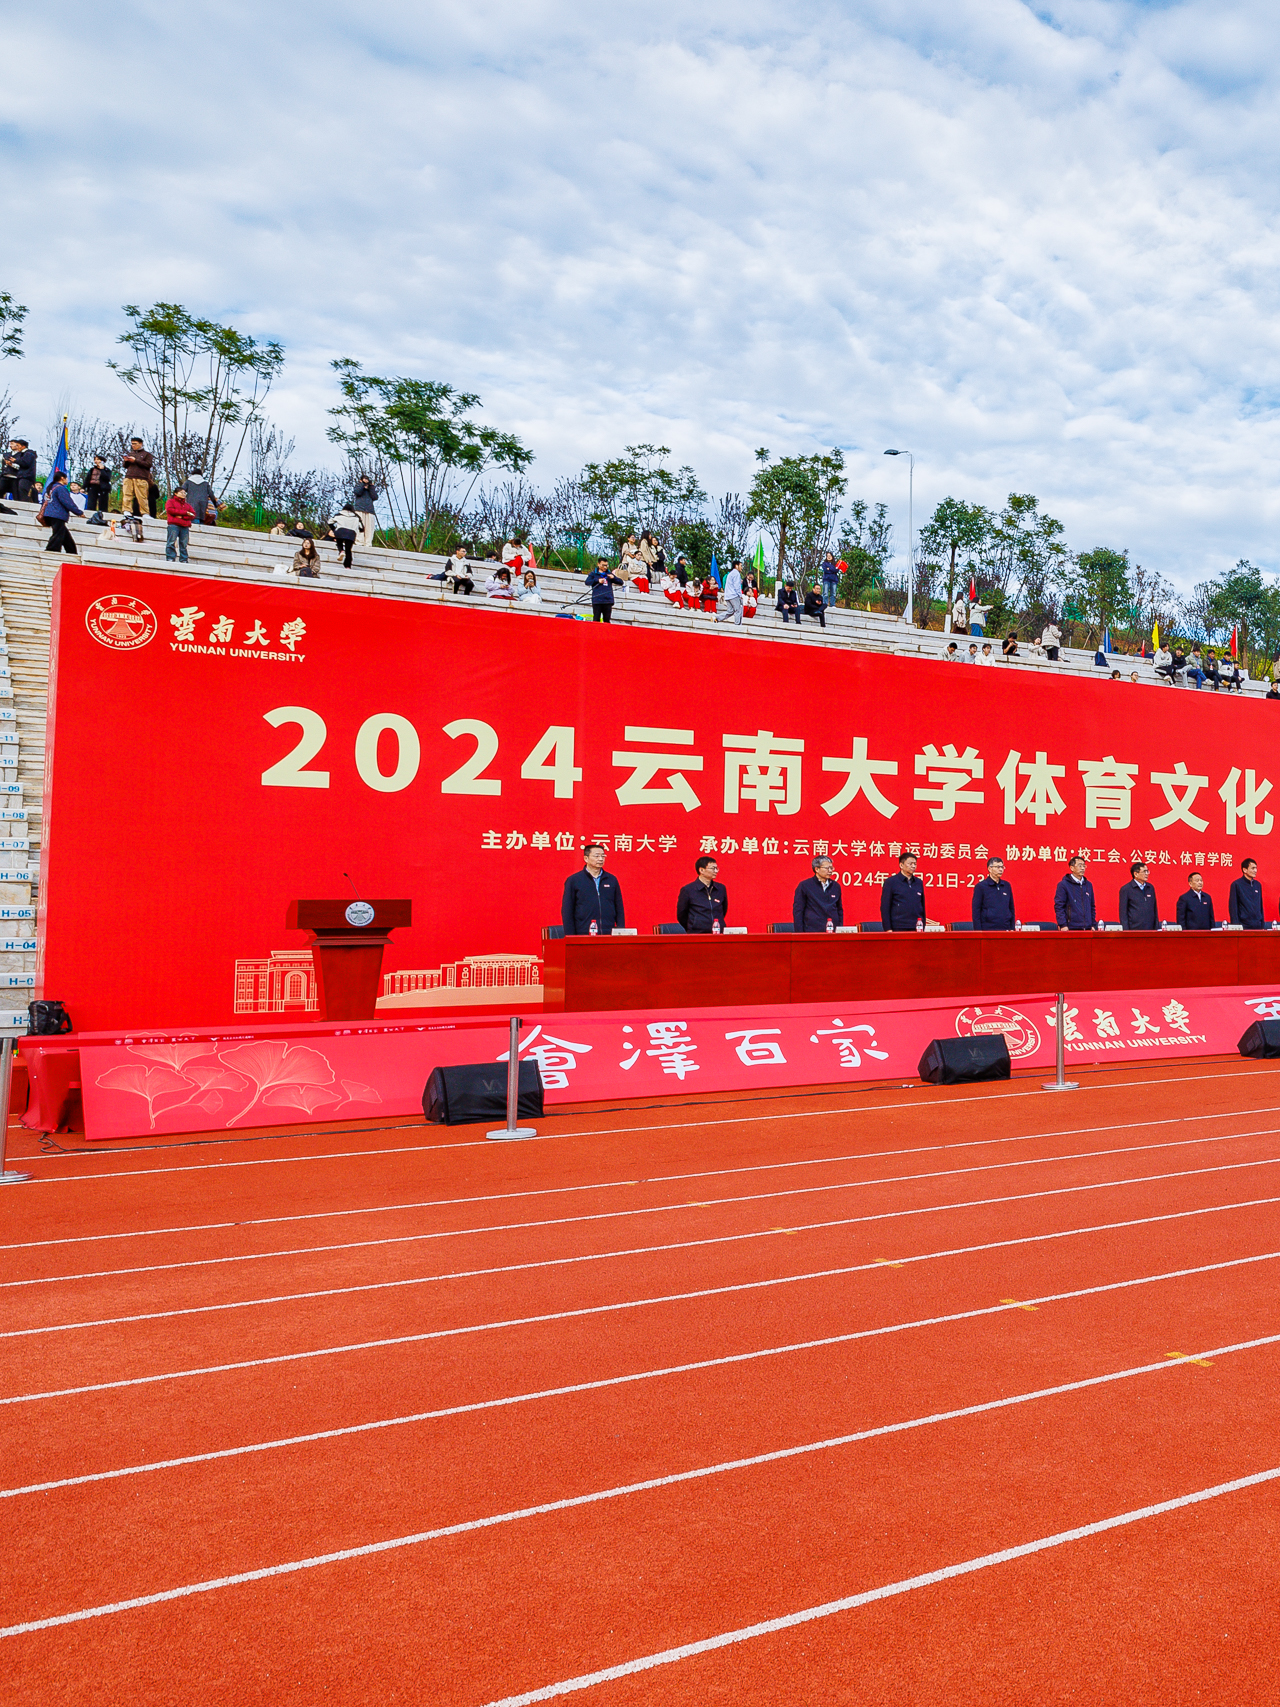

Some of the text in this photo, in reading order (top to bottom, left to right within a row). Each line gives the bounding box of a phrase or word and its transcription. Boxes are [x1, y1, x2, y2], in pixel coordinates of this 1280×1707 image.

[114, 624, 153, 647] UNIVERSITY
[170, 642, 306, 663] YUNNAN UNIVERSITY
[0, 785, 20, 793] -09
[0, 872, 29, 880] H-06
[1, 909, 31, 918] H-05
[5, 941, 36, 950] H-04
[9, 977, 34, 986] H-0
[1008, 1028, 1036, 1056] NIVERSITY
[1063, 1034, 1208, 1053] YUNNAN UNIVERSITY
